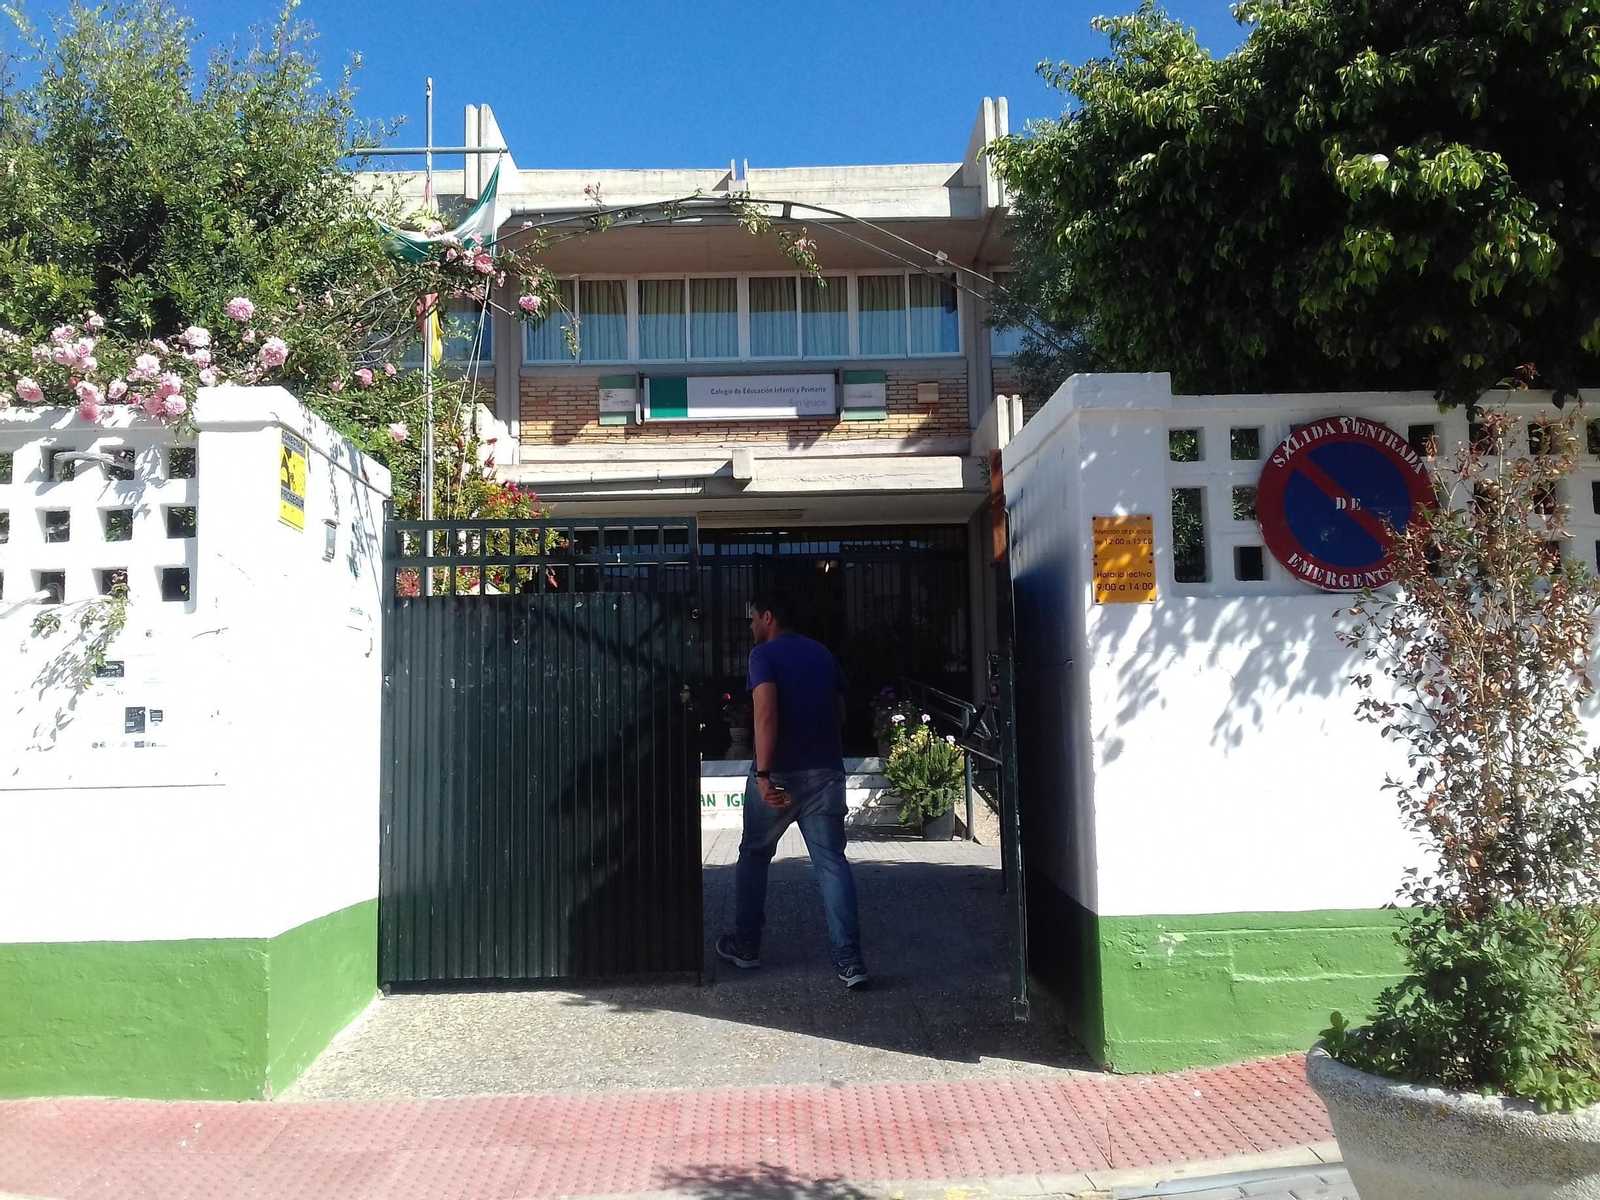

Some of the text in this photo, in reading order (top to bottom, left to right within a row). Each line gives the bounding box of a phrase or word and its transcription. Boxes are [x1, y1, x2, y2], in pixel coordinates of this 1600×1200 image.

[711, 388, 733, 396] Colegio
[742, 387, 773, 395] Educación
[790, 399, 827, 408] San Ignacio
[1273, 421, 1337, 468] SALIDA
[1354, 422, 1424, 475] ENTRADA
[281, 487, 304, 510] PROSEGUR
[1336, 497, 1362, 511] DE
[1287, 552, 1396, 588] EMERGENC
[1097, 583, 1117, 591] 9:00
[1129, 582, 1154, 591] 14:00
[701, 793, 716, 807] AN
